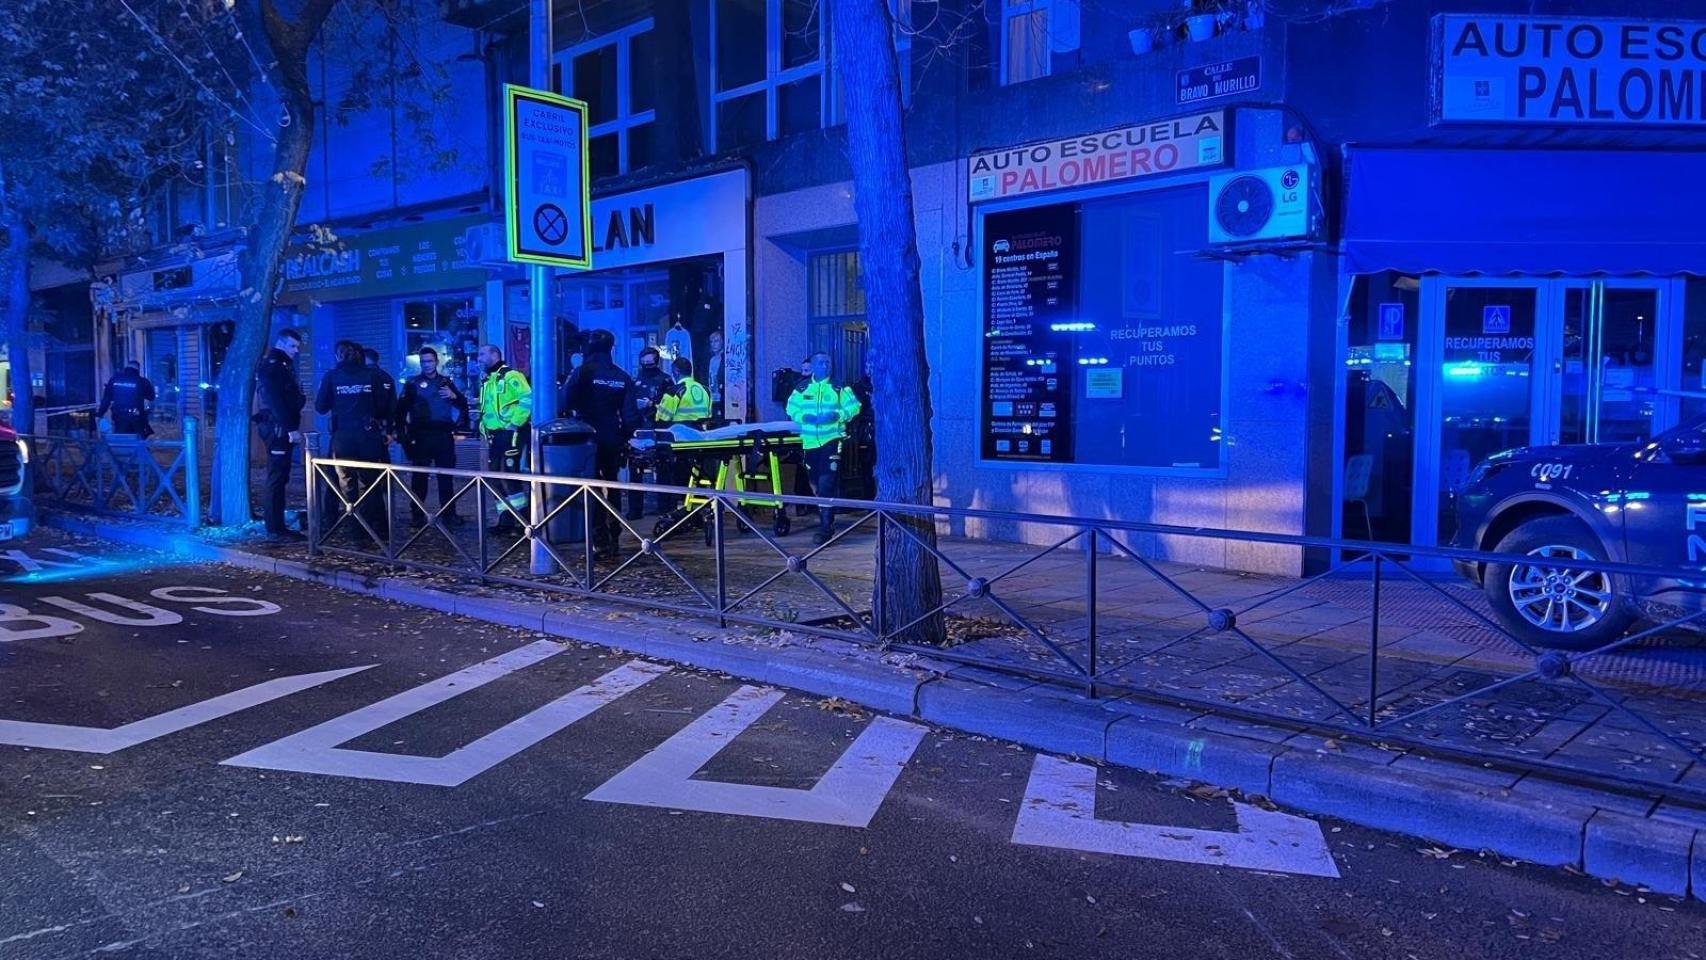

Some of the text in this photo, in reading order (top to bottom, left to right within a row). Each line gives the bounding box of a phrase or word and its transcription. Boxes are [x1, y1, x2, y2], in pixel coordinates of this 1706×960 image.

[1451, 21, 1604, 59] AUTO
[1204, 62, 1233, 76] CALLE
[1180, 75, 1256, 101] BRAVO MURILLO
[1517, 66, 1706, 120] PALOM
[532, 109, 566, 122] CARRIL
[524, 118, 573, 136] EXCLUSIVO
[971, 115, 1220, 174] AUTO ESCUELA
[1000, 143, 1179, 195] PALOMERO
[1282, 192, 1297, 203] LG
[1011, 235, 1062, 250] PALOMERO
[1002, 253, 1026, 263] centros
[1035, 250, 1058, 261] España
[1110, 325, 1197, 340] RECUPERAMOS
[1141, 340, 1163, 352] TUS
[1445, 337, 1534, 349] RECUPERAMOS
[1129, 354, 1175, 366] PUNTOS
[1478, 351, 1501, 362] TUS
[0, 586, 282, 642] BUS
